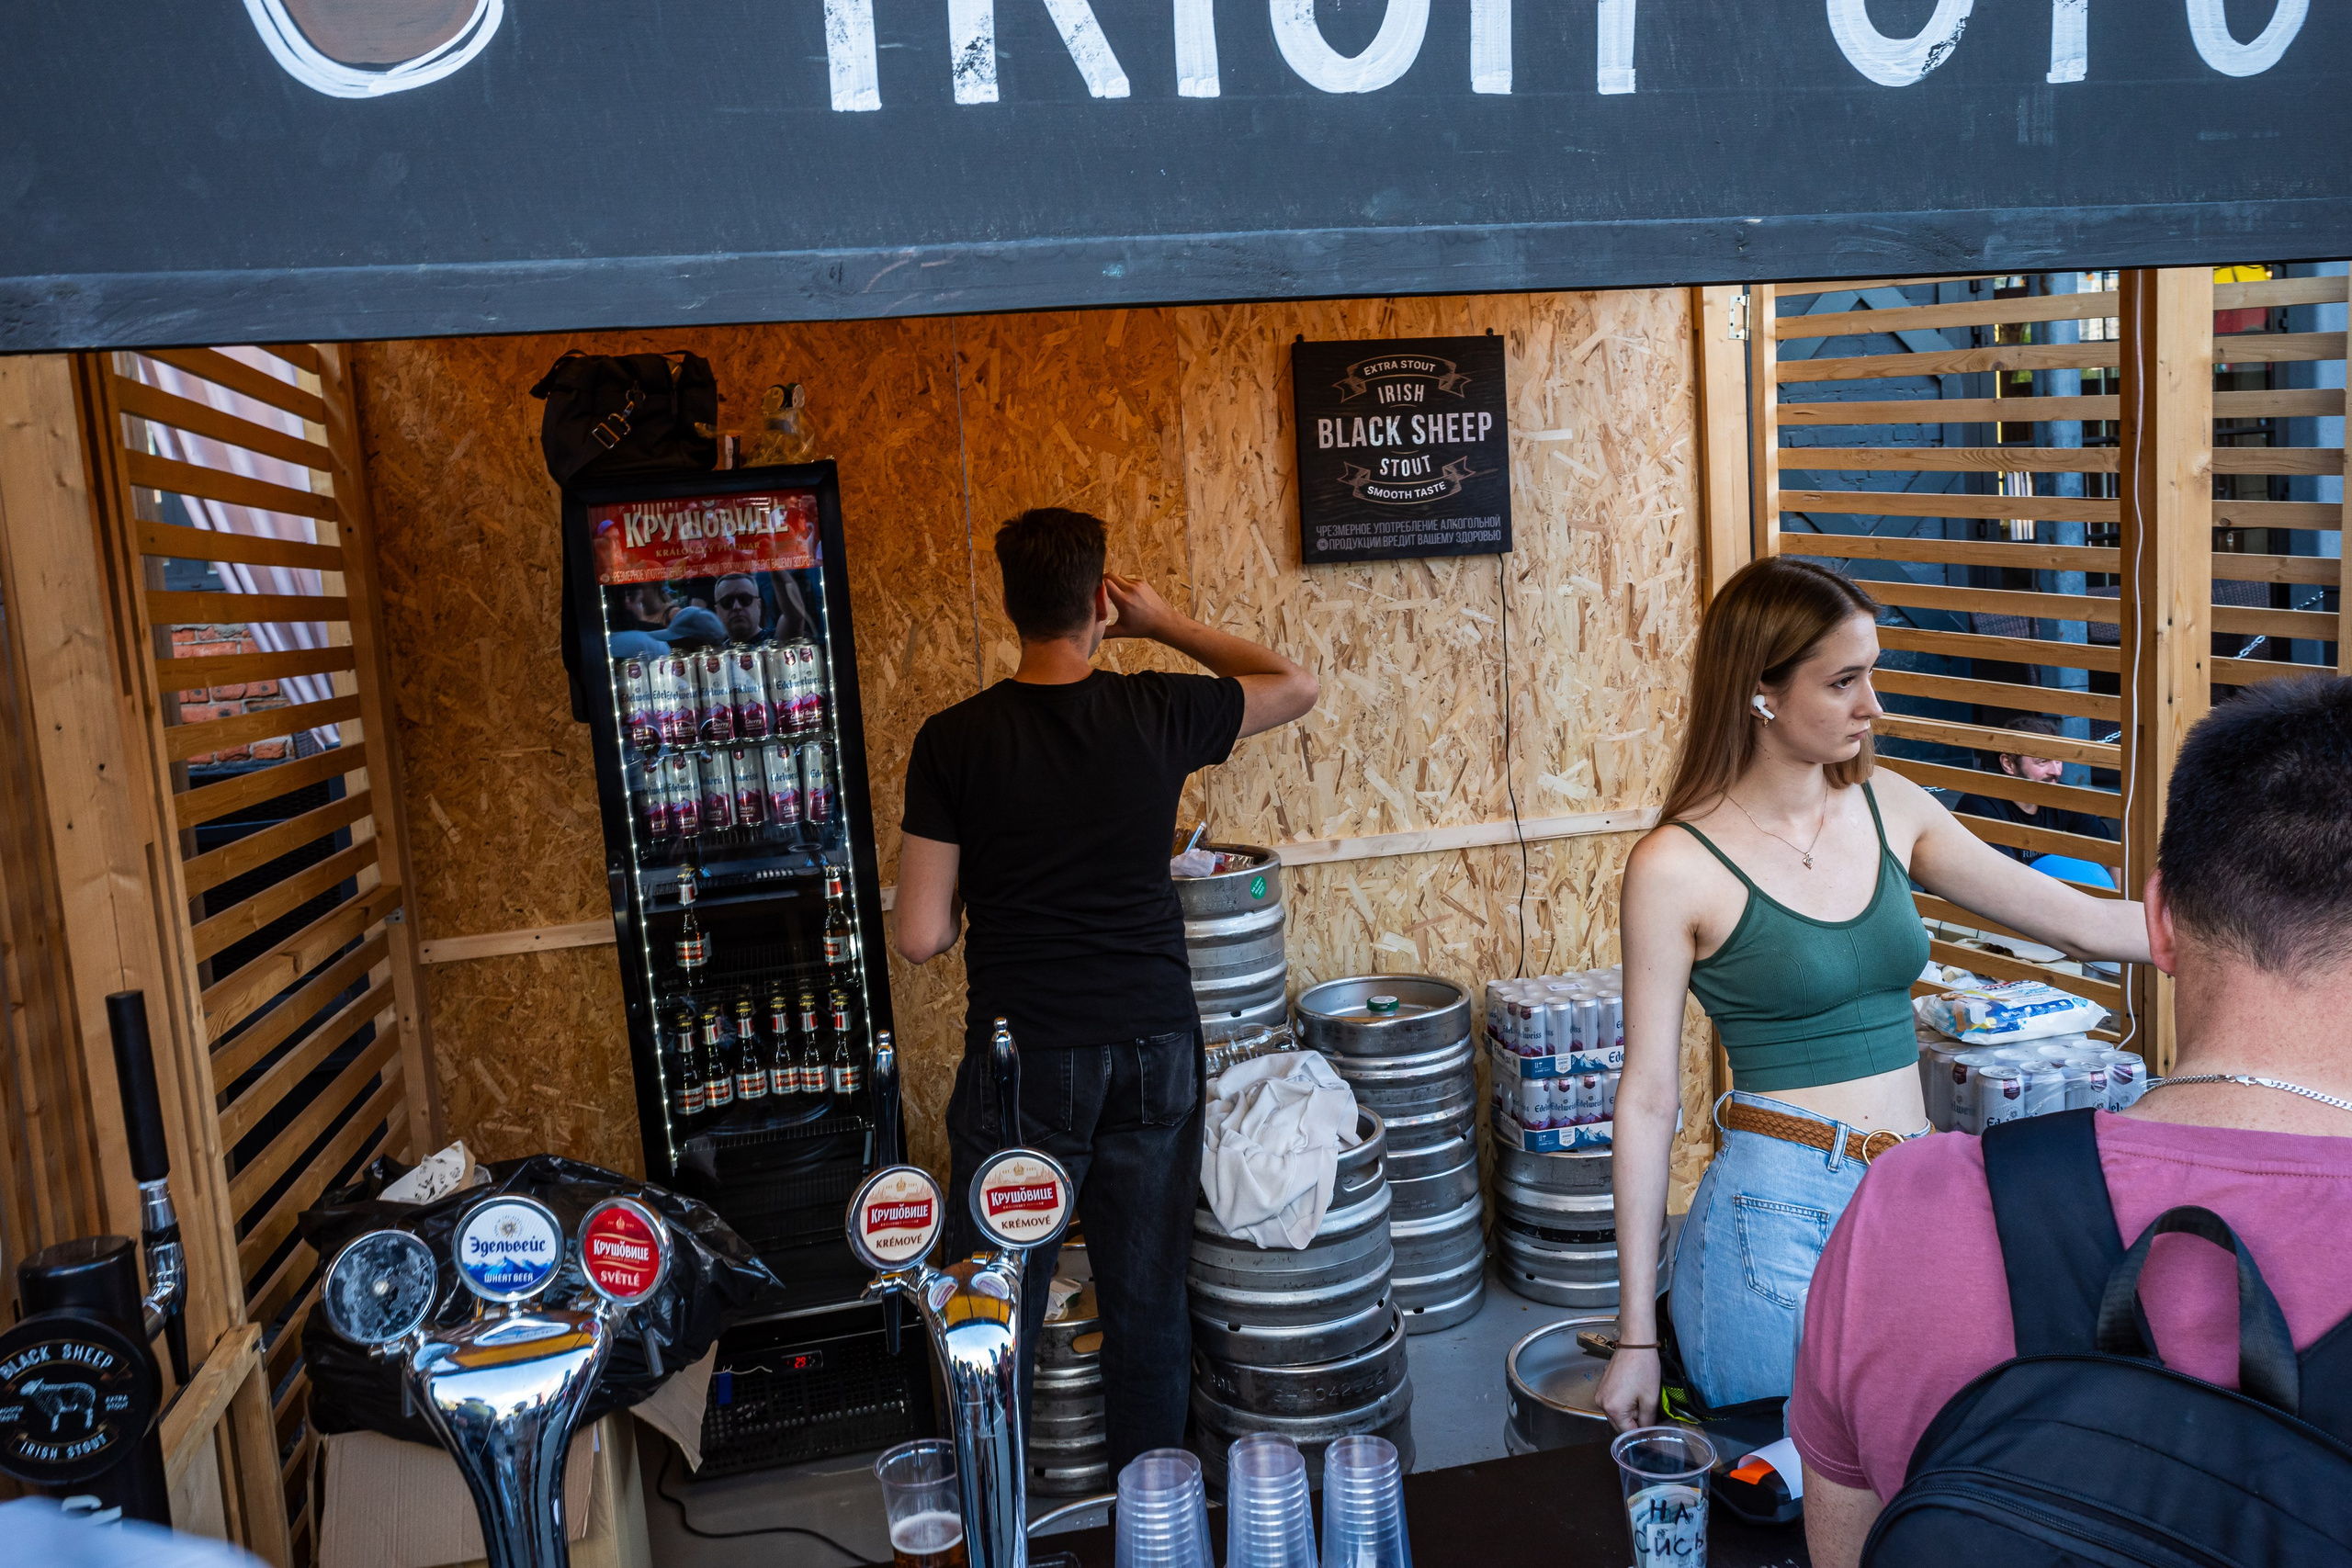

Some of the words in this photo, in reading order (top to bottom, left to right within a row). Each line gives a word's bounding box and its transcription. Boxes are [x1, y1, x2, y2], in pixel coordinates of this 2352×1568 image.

[1363, 361, 1398, 376] EXTRA
[1400, 360, 1436, 373] STOUT
[1378, 384, 1425, 404] IRISH
[1317, 415, 1403, 449] BLACK
[1411, 412, 1492, 445] SHEEP
[1380, 455, 1431, 477] STOUT
[1367, 485, 1412, 500] SMOOTH
[1414, 481, 1446, 499] TASTE
[1316, 523, 1372, 536] ЧРЕЗМЕРНОЕ
[1373, 519, 1439, 535] УПОТРЕБЛЕНИЕ
[1440, 514, 1501, 531] АЛКОГОЛЬНОЙ
[1329, 536, 1380, 550] ПРОДУКЦИИ
[1383, 534, 1416, 548] ВРЕДИТ
[1417, 532, 1454, 546] ВАШЕМУ
[1455, 528, 1501, 544] ЗДОРОВЬЮ
[1001, 1214, 1051, 1230] KRÉMOVÉ
[469, 1235, 548, 1258] Эдельвейс
[876, 1233, 922, 1249] KRÉMOVÉ
[483, 1273, 512, 1284] WHEAT
[513, 1272, 534, 1283] BEER
[600, 1269, 640, 1288] SVĚTLÉ
[0, 1346, 51, 1381] BLACK
[62, 1343, 114, 1369] SHEEP
[795, 1356, 807, 1369] 29
[19, 1441, 59, 1461] IRISH
[66, 1433, 107, 1459] STOUT
[1650, 1498, 1689, 1526] НА
